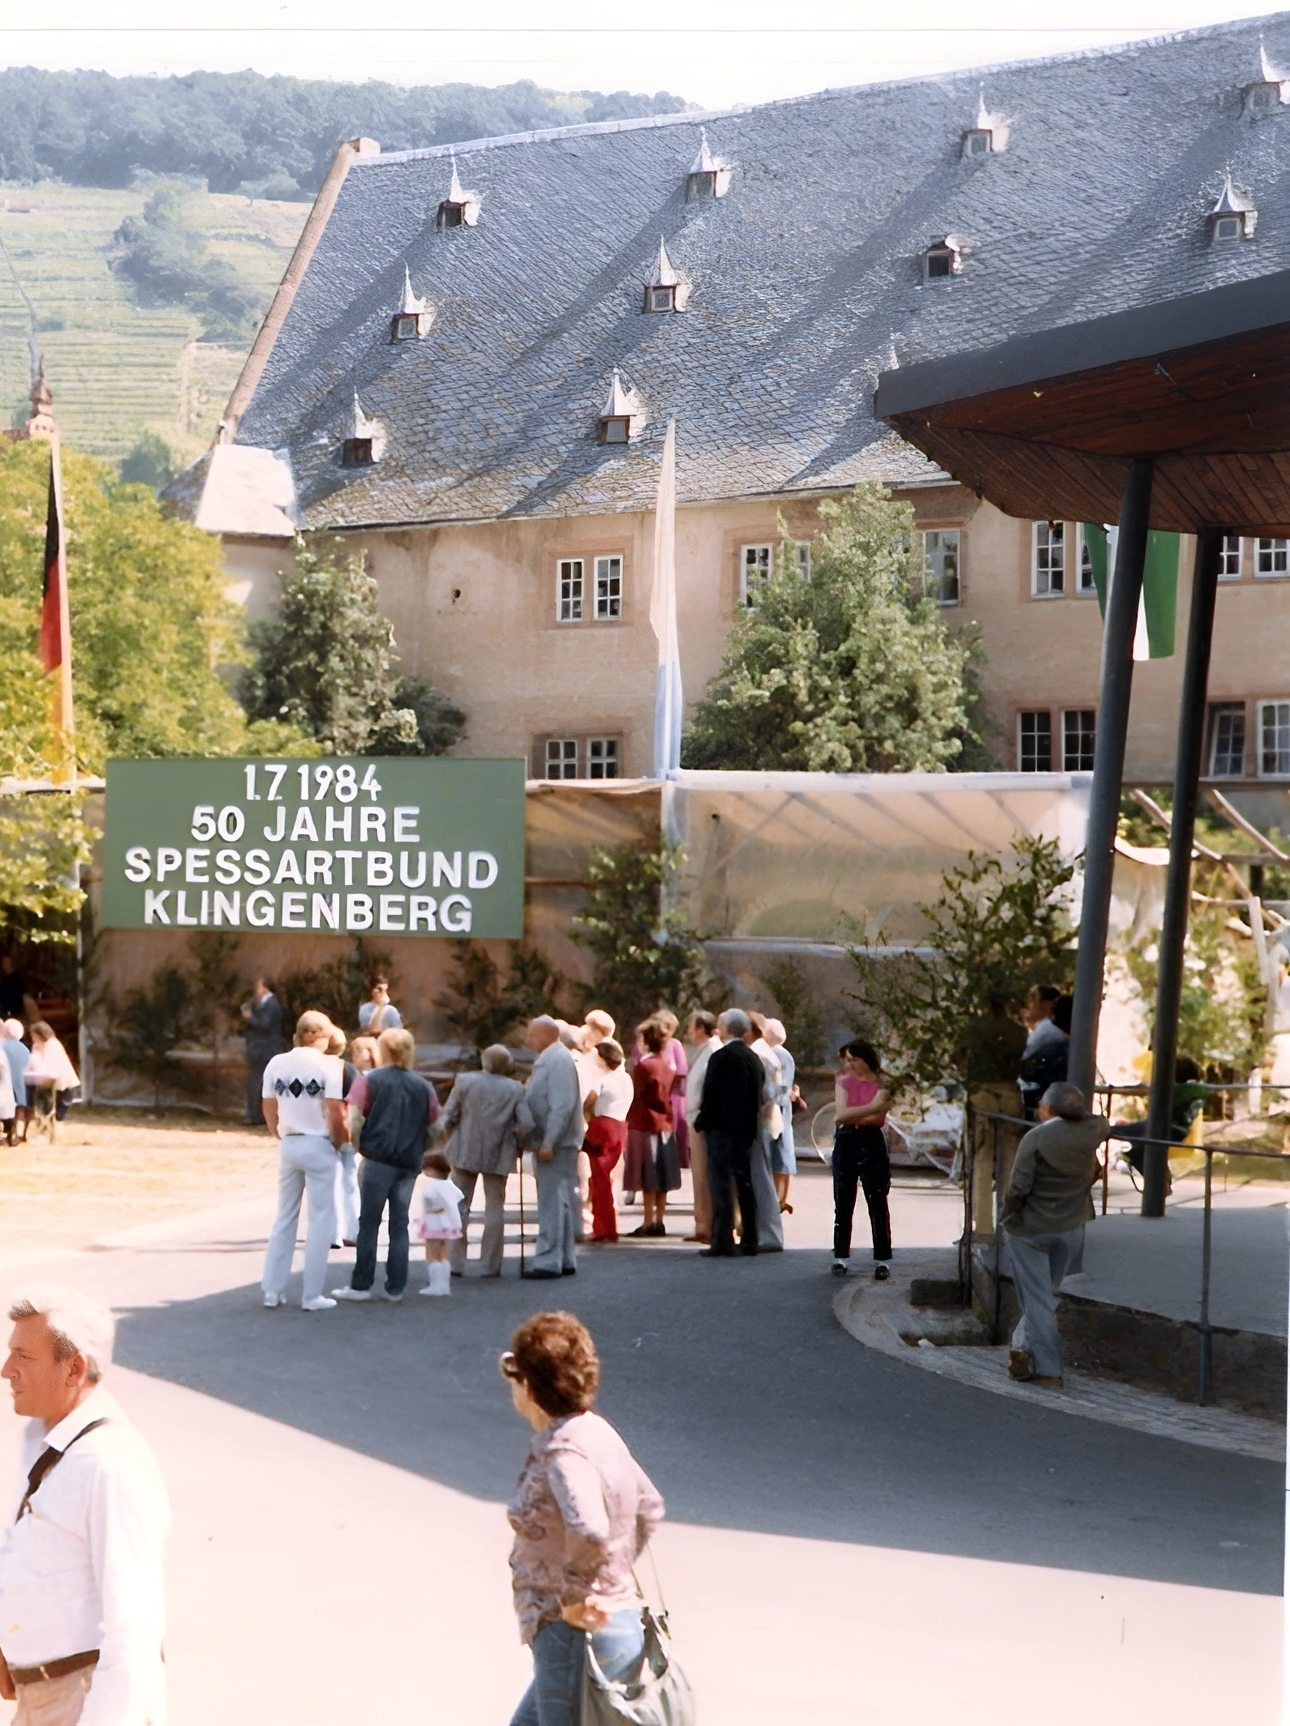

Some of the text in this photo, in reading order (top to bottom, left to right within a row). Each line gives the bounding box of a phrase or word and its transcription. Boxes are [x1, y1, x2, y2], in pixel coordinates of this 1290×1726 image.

[191, 804, 421, 843] 50 JAHRE
[124, 846, 499, 889] SPESSARTBUND
[144, 888, 472, 933] KLINGENBERG
